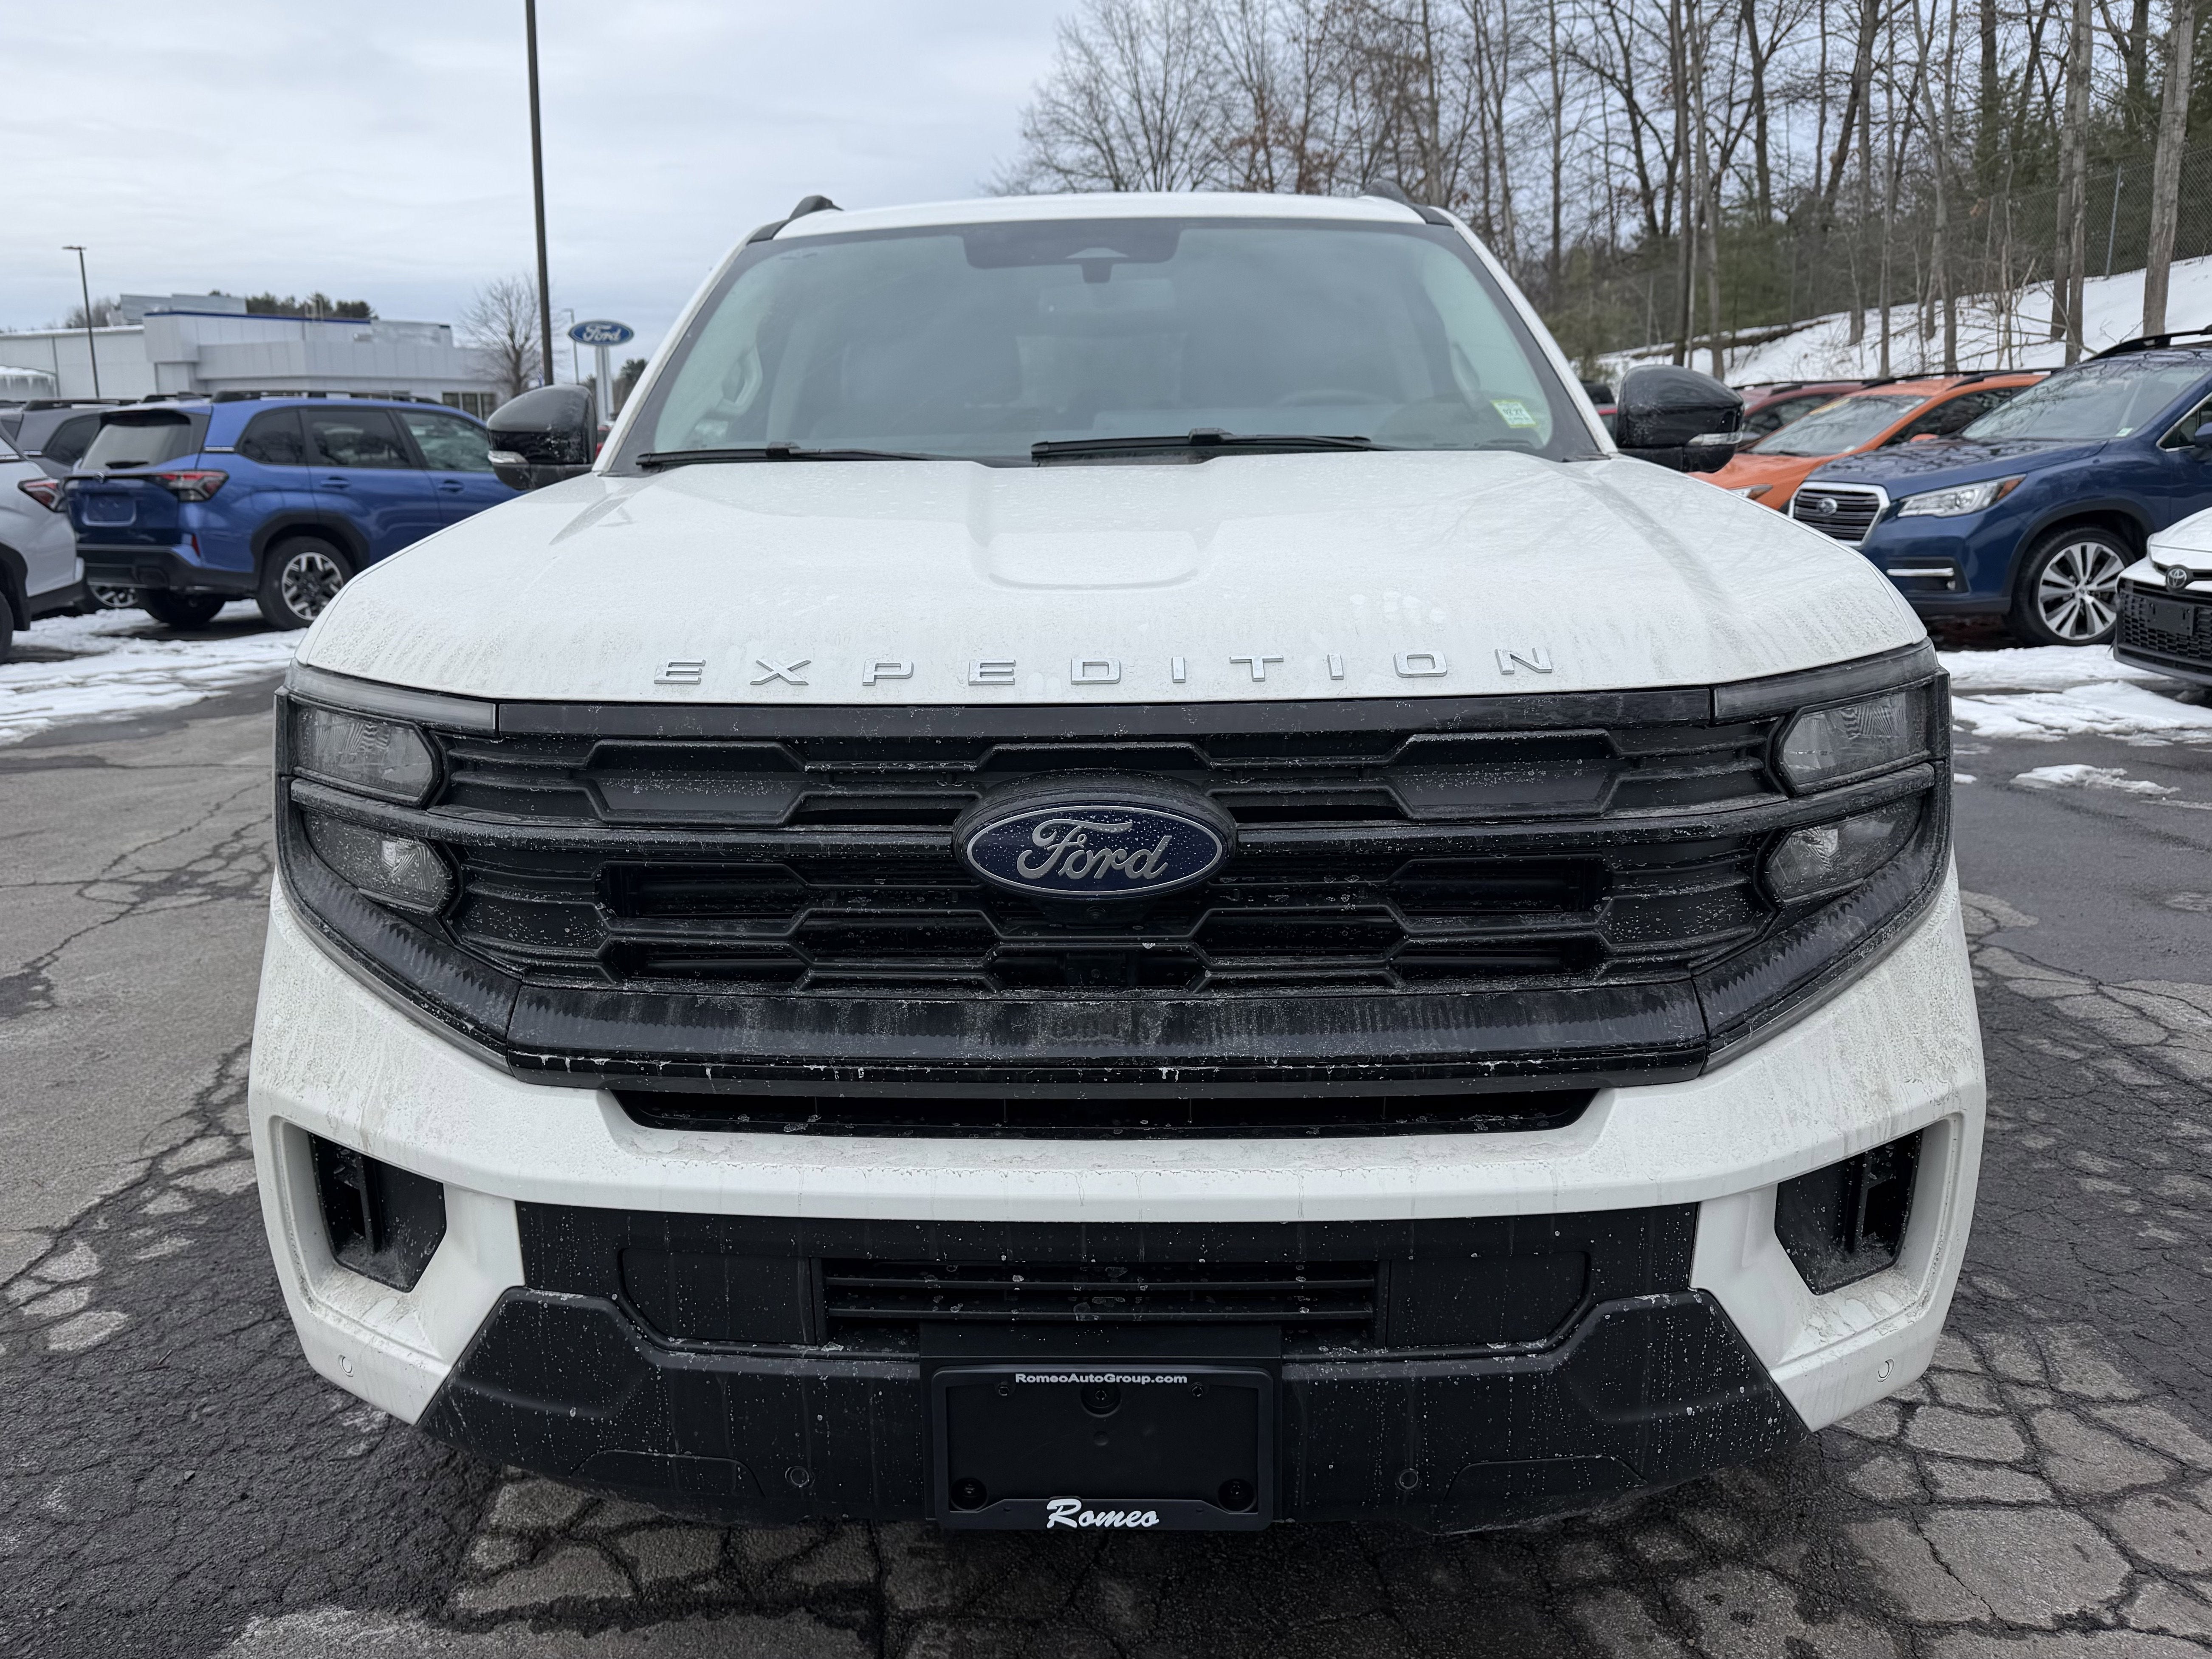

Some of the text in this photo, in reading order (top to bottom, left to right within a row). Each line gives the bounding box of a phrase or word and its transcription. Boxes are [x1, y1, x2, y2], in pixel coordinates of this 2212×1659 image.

[582, 324, 621, 341] Ford
[654, 646, 1553, 686] EXPEDITION
[1017, 819, 1172, 879] Ford
[1015, 1373, 1188, 1385] RomeoAutoGroup.com
[1047, 1498, 1160, 1528] Romeo
